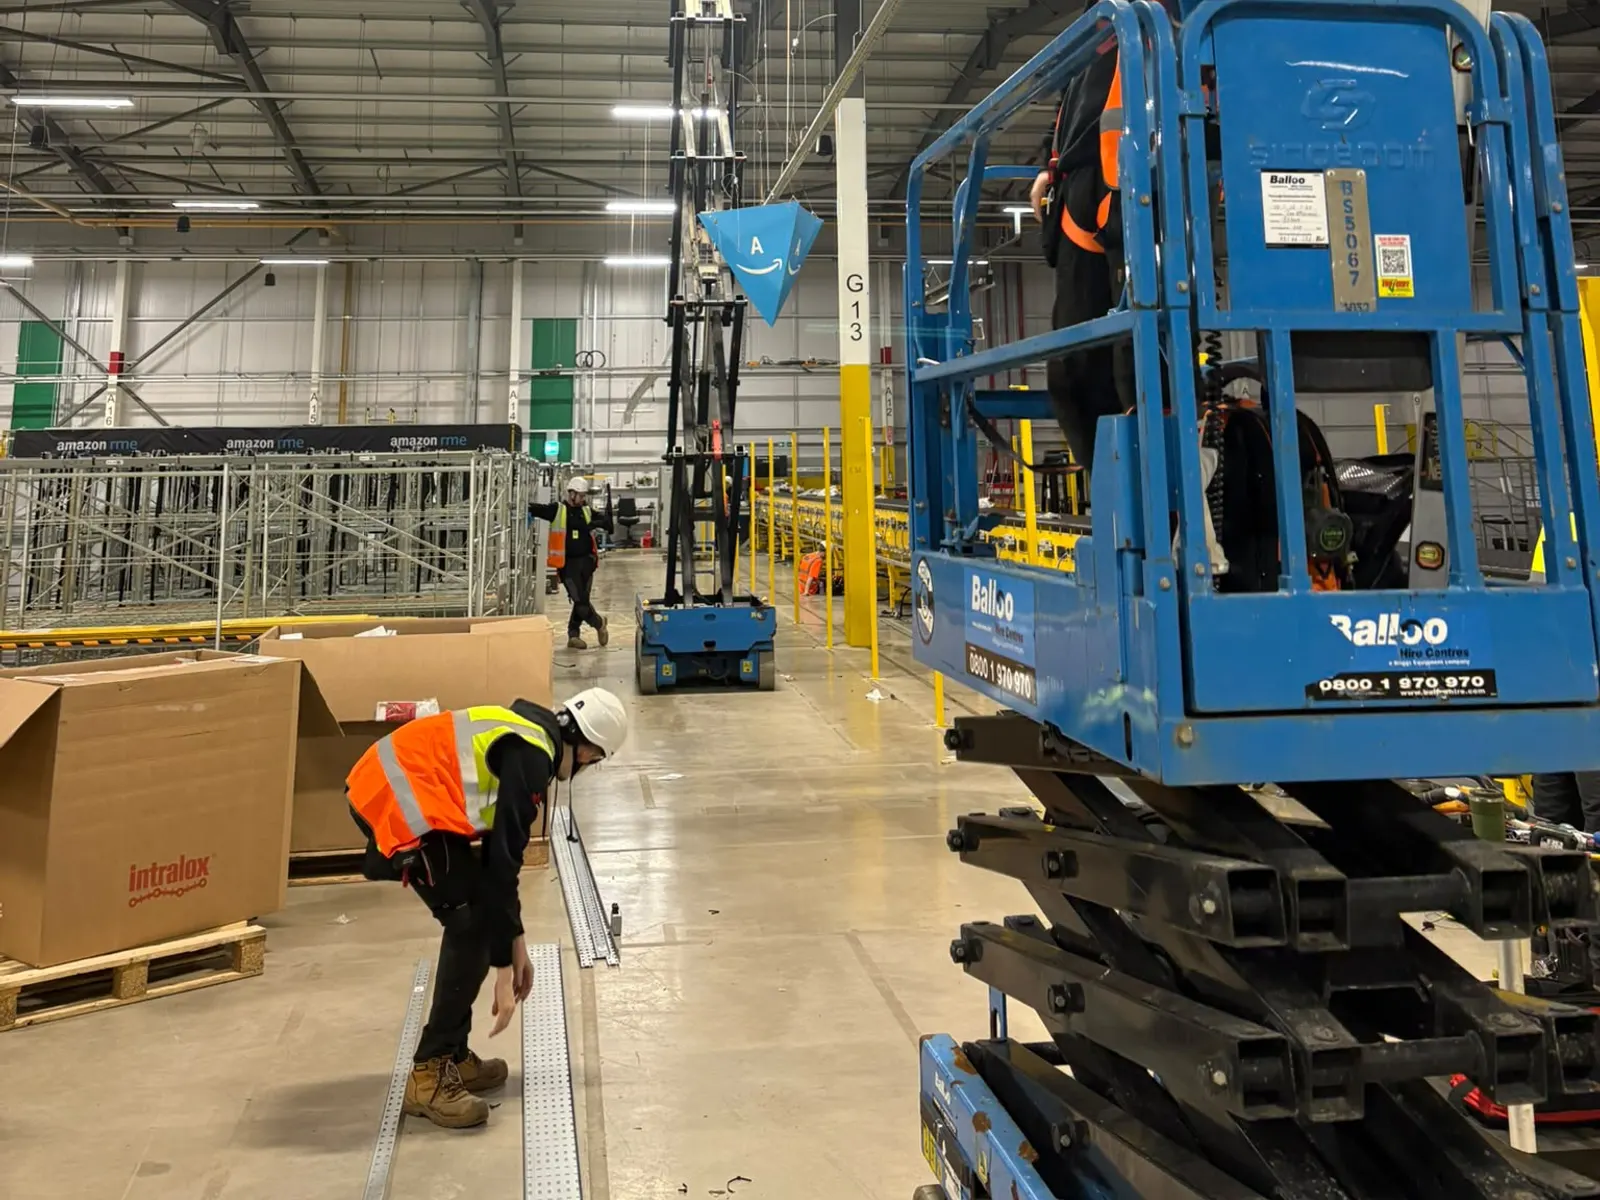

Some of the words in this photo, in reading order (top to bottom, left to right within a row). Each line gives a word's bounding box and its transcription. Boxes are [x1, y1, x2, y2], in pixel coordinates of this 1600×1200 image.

[1270, 175, 1306, 185] Balloo
[750, 236, 765, 256] A
[57, 440, 107, 451] amazon
[109, 439, 138, 450] rme
[226, 437, 275, 449] amazon
[277, 437, 305, 449] rme
[390, 435, 438, 446] amazon
[440, 434, 467, 446] rme
[971, 575, 1014, 622] Balloo
[1329, 613, 1448, 646] Balloo
[1400, 648, 1423, 659] Hire
[1426, 647, 1469, 658] Centres
[970, 652, 989, 679] 0800
[996, 663, 1012, 690] 970
[1014, 670, 1031, 699] 970
[1319, 678, 1373, 691] 0800
[1380, 678, 1390, 690] 1
[1399, 677, 1438, 689] 970
[1445, 676, 1485, 687] 970
[129, 854, 210, 892] intralox
